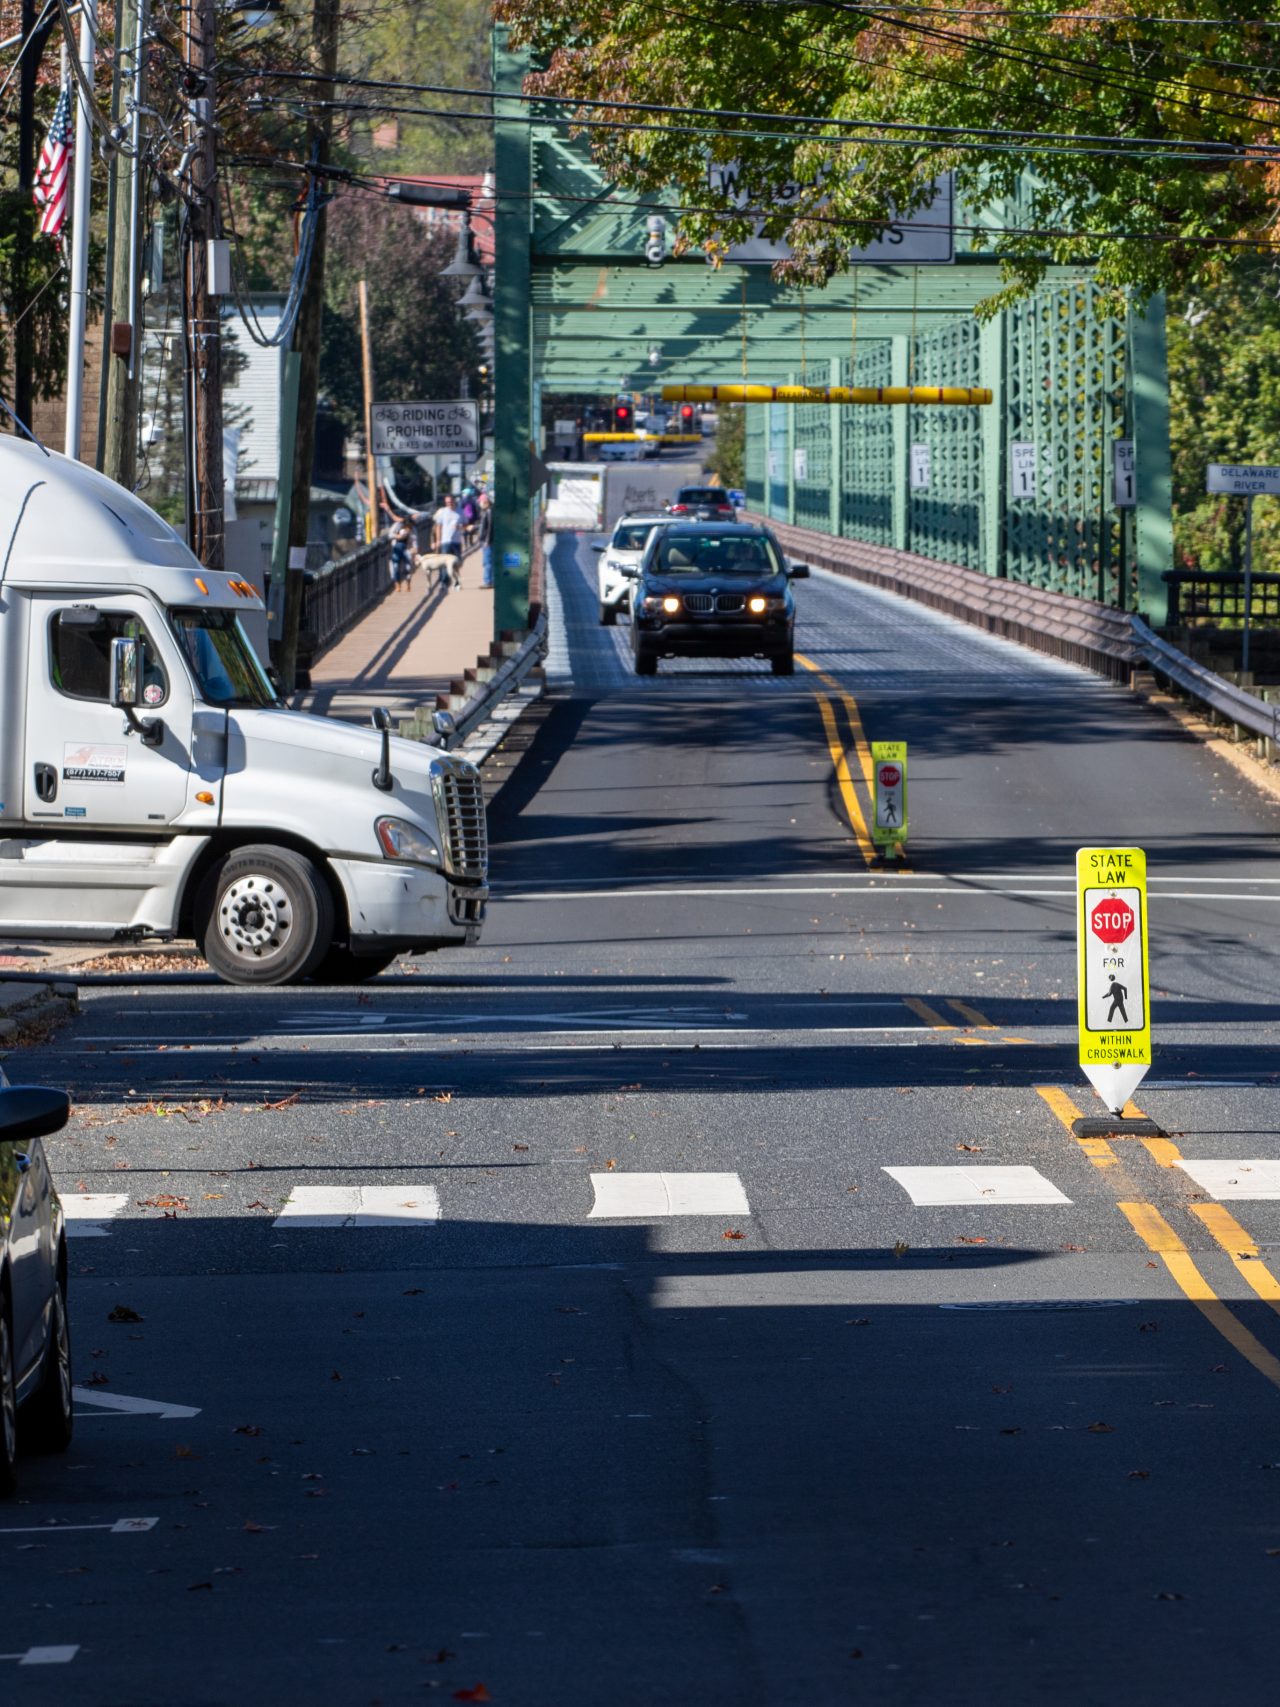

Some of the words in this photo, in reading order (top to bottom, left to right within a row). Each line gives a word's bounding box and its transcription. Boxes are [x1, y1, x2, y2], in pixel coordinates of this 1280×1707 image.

[402, 409, 446, 421] RIDING
[386, 424, 462, 438] PROHIBITED
[375, 440, 395, 449] WALK
[399, 440, 420, 449] BIKES
[423, 441, 434, 449] ON
[1015, 448, 1035, 457] SPE
[1221, 467, 1279, 479] DELAWARE
[1234, 480, 1266, 490] RIVER
[66, 768, 87, 777] (877)
[881, 772, 898, 781] STOP
[1090, 854, 1133, 868] STATE
[1097, 871, 1126, 884] LAW
[1094, 913, 1132, 930] STOP
[1103, 958, 1125, 968] FOR
[1100, 1035, 1132, 1045] WITHIN
[1087, 1048, 1145, 1059] CROSSWALK
